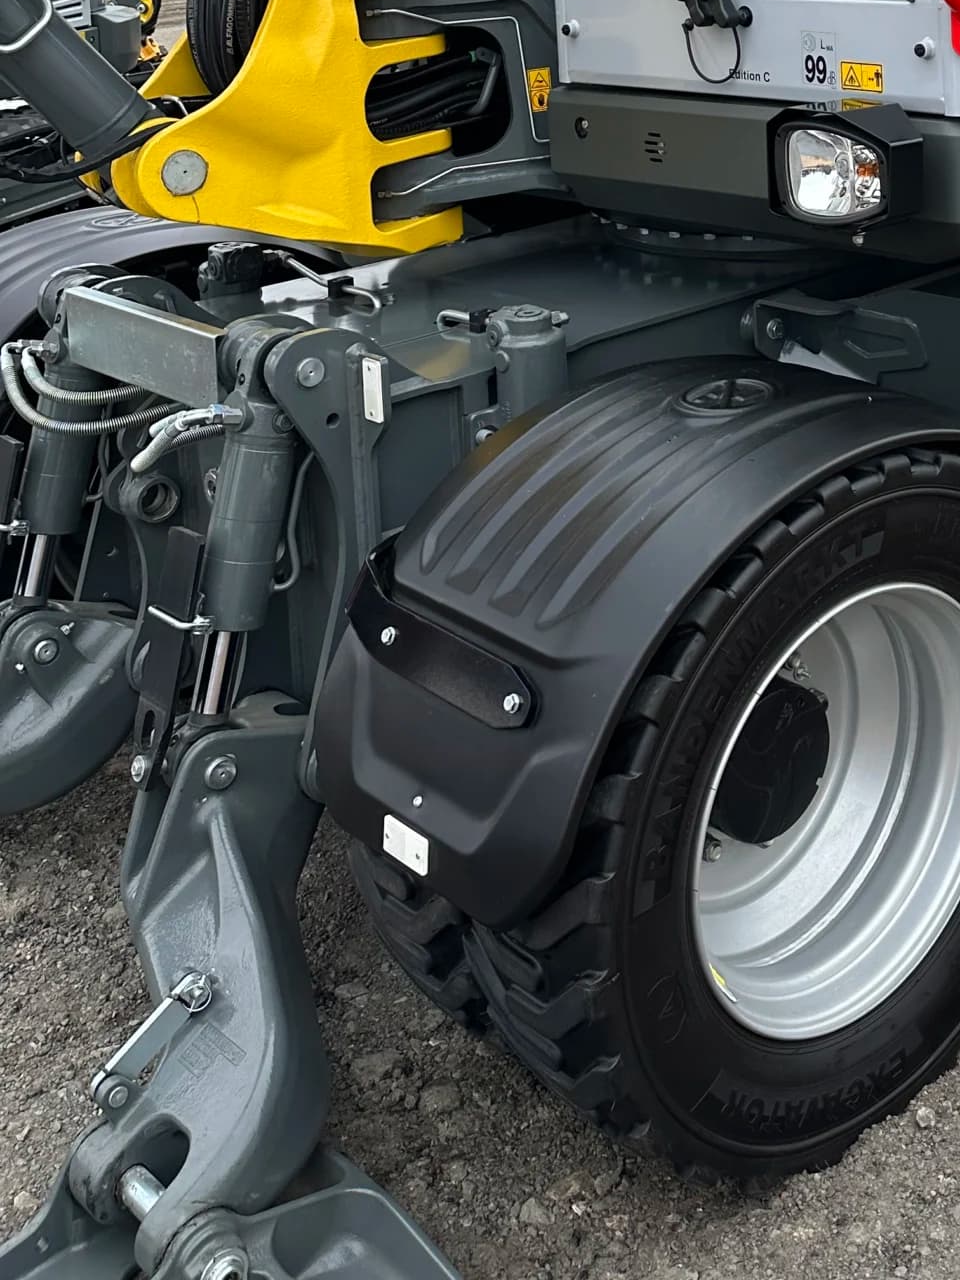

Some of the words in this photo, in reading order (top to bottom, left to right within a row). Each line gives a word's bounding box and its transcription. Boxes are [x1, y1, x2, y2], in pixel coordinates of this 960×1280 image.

[728, 68, 761, 81] Edition
[763, 71, 771, 83] C
[804, 54, 827, 84] 99
